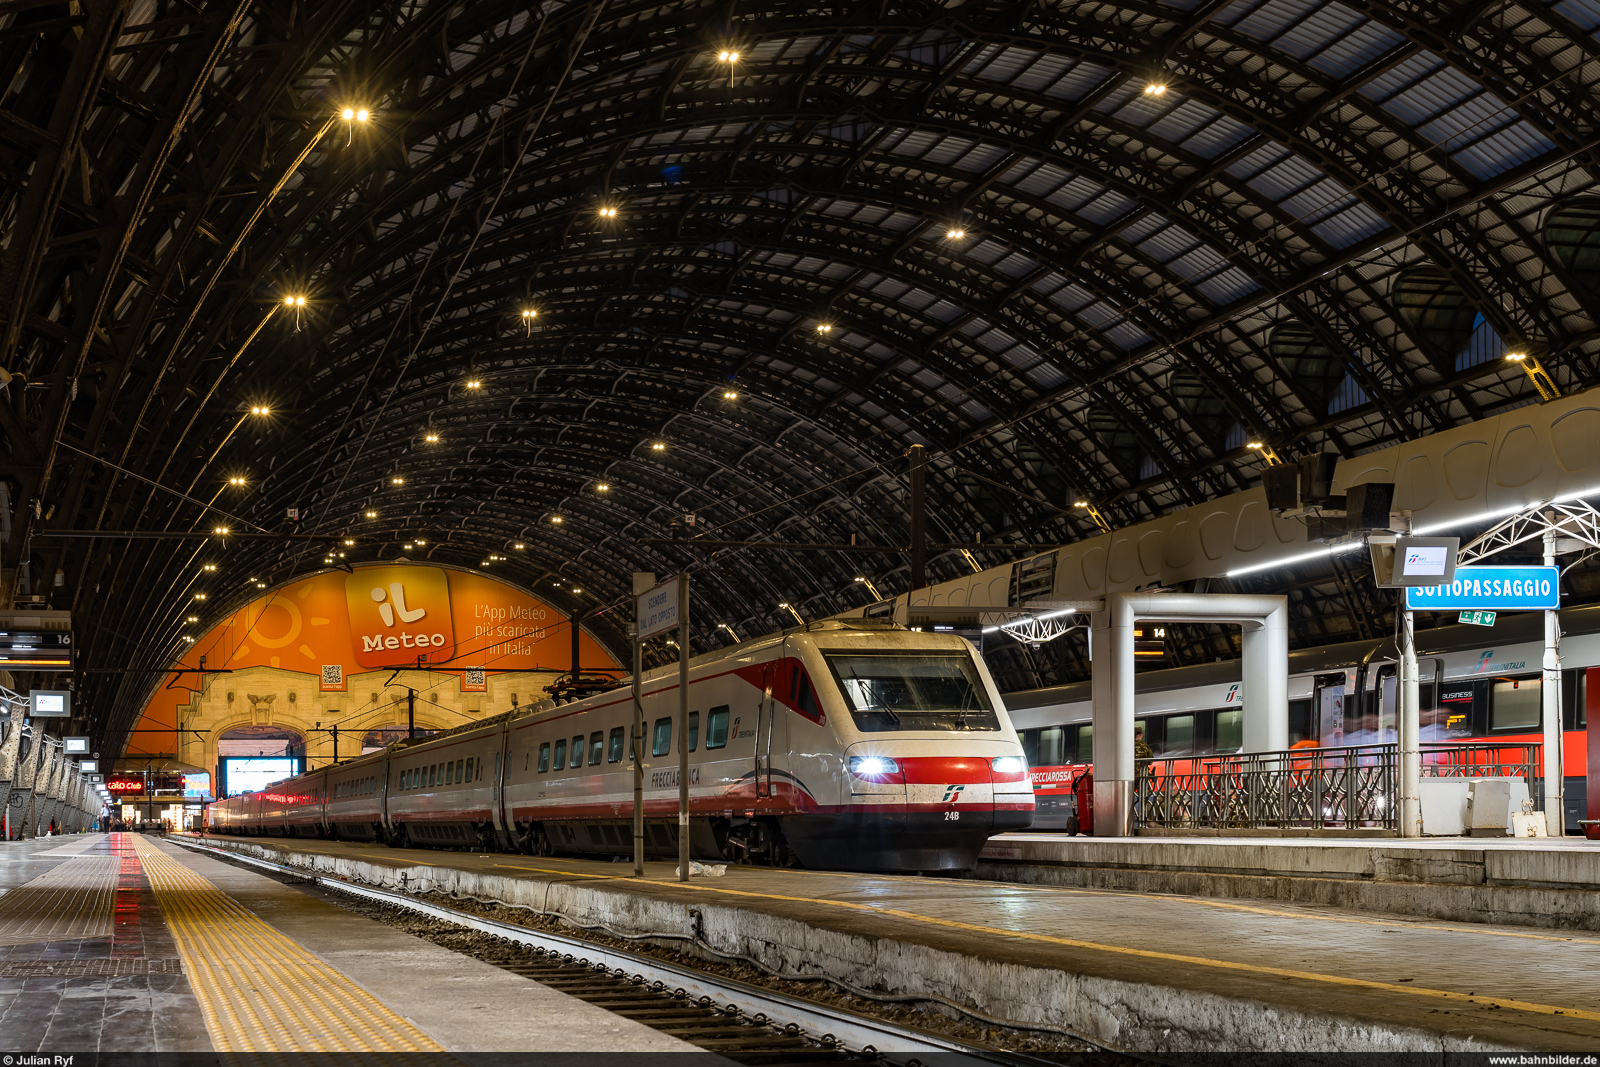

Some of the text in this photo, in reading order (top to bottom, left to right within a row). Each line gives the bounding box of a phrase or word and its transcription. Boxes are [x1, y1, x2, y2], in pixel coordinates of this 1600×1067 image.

[508, 605, 547, 621] Meteo
[658, 605, 676, 623] OPPOSTO
[474, 622, 546, 640] più scaricata
[1153, 628, 1166, 638] 14
[57, 634, 71, 645] 16
[361, 631, 446, 653] Meteo
[489, 641, 532, 656] in Italia
[1490, 661, 1526, 671] TRENITALIA
[1441, 690, 1473, 700] BUSINESS
[126, 782, 142, 790] Club
[944, 811, 960, 821] 24B
